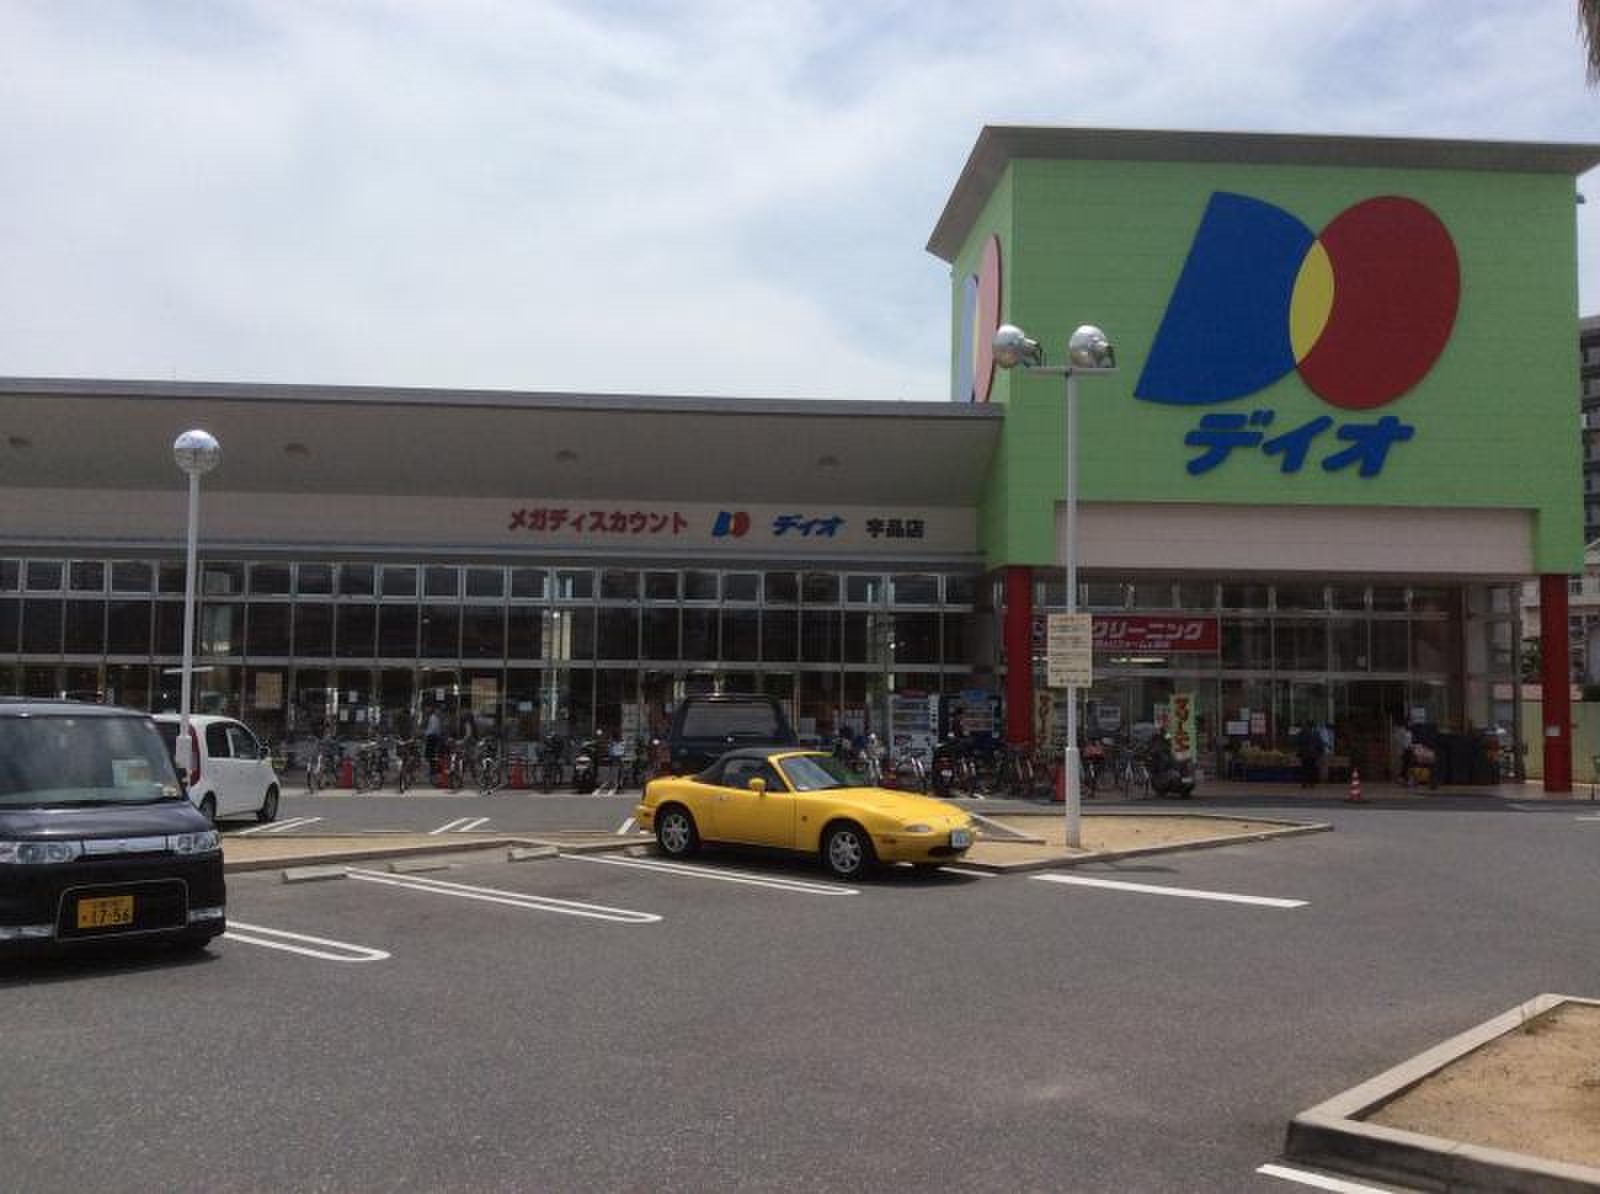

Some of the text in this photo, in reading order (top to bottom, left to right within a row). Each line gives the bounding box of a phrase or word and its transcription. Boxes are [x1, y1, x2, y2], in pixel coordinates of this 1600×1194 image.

[508, 508, 688, 535] メガディスカウント
[866, 517, 925, 539] 宇品店
